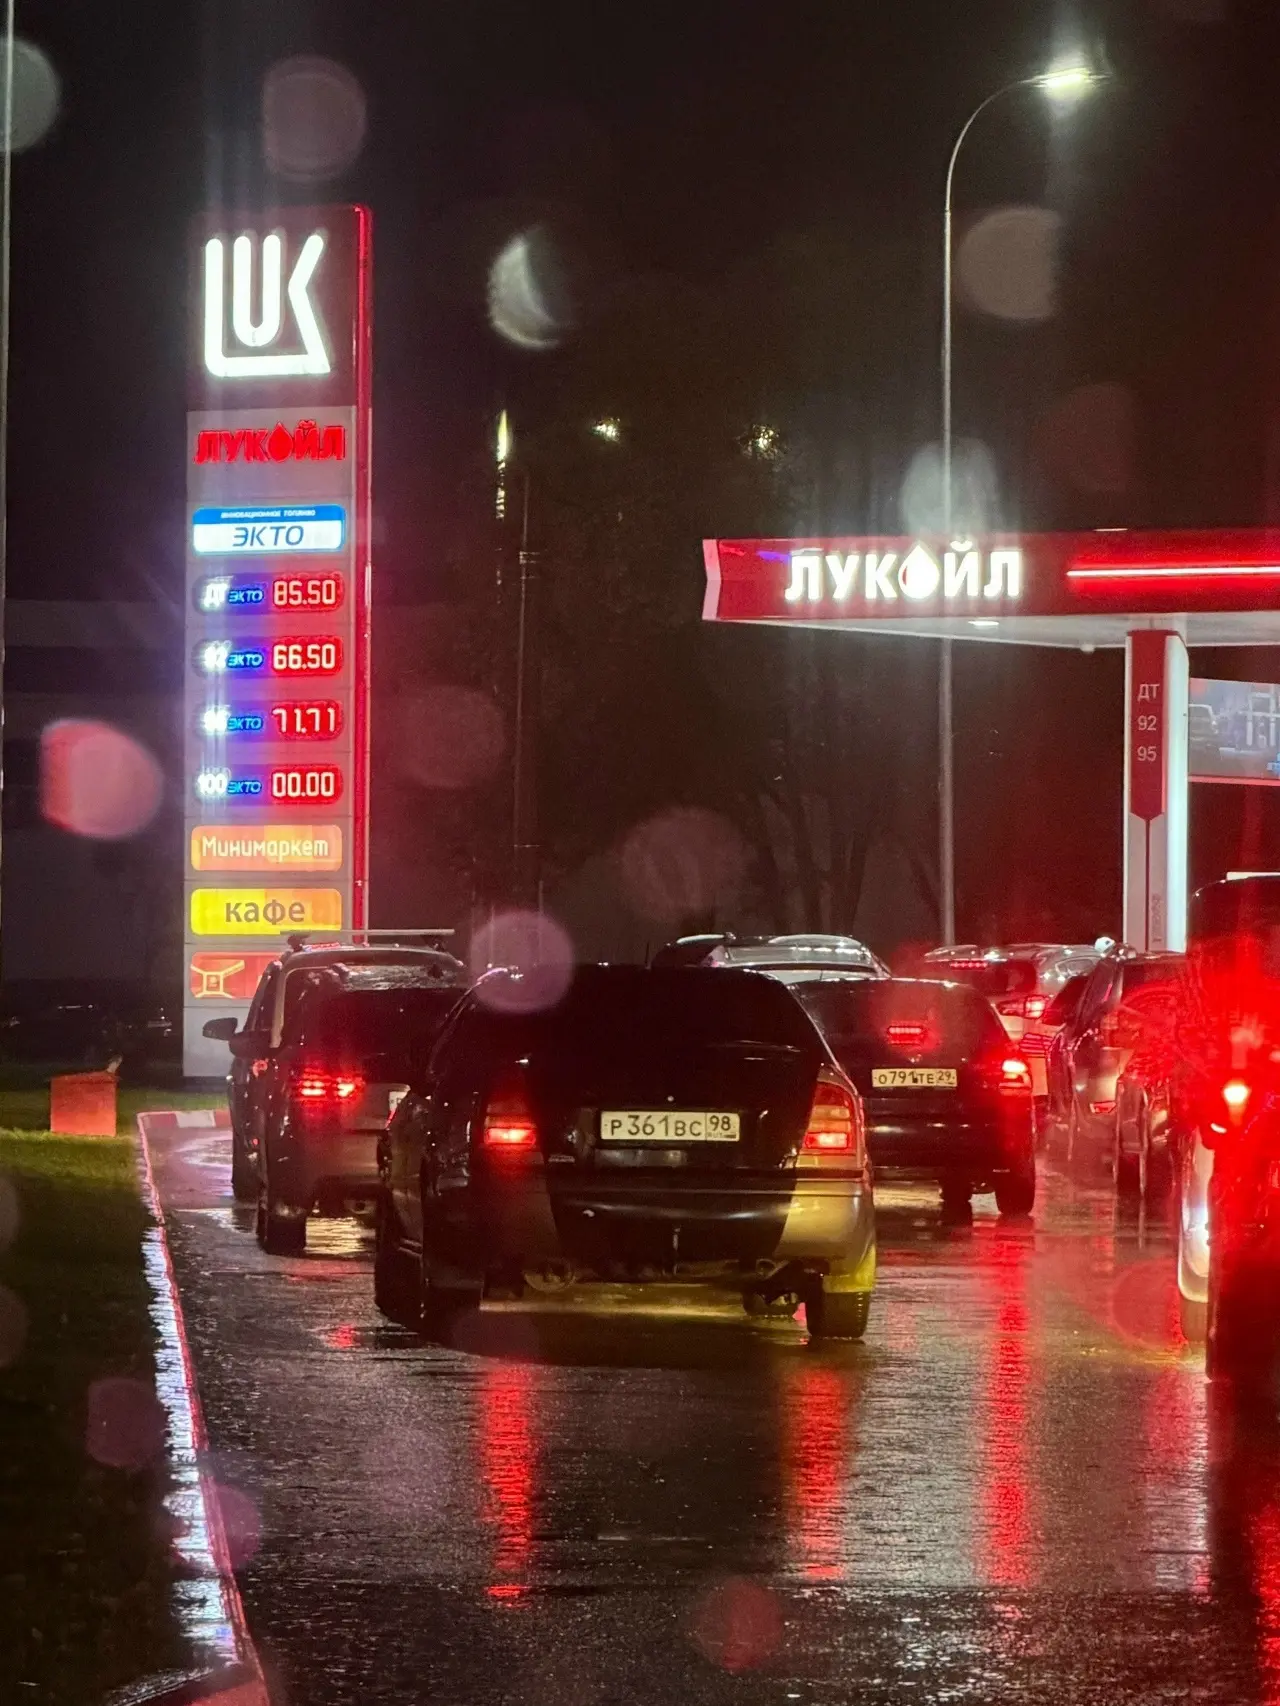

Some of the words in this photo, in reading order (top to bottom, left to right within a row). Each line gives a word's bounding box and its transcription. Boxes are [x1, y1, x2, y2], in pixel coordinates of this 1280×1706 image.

[193, 419, 346, 464] ЛУКОЙЛ
[232, 524, 304, 547] ЭКТО
[784, 540, 1021, 600] ЛУКОЙЛ
[228, 589, 263, 603] ЭКТО
[272, 579, 336, 606] 85.50
[228, 653, 263, 666] ЭКТО
[272, 644, 336, 670] 66.50
[1137, 683, 1160, 701] ДТ
[227, 717, 262, 730] ЭКТО
[272, 707, 336, 734] 71.71
[1137, 715, 1157, 731] 92
[1137, 745, 1157, 762] 95
[227, 781, 262, 794] ЭКТО
[271, 771, 335, 797] 00.00
[201, 835, 329, 862] Минимаркет
[224, 899, 305, 926] кафе
[938, 1070, 952, 1081] 29
[709, 1115, 731, 1131] 98
